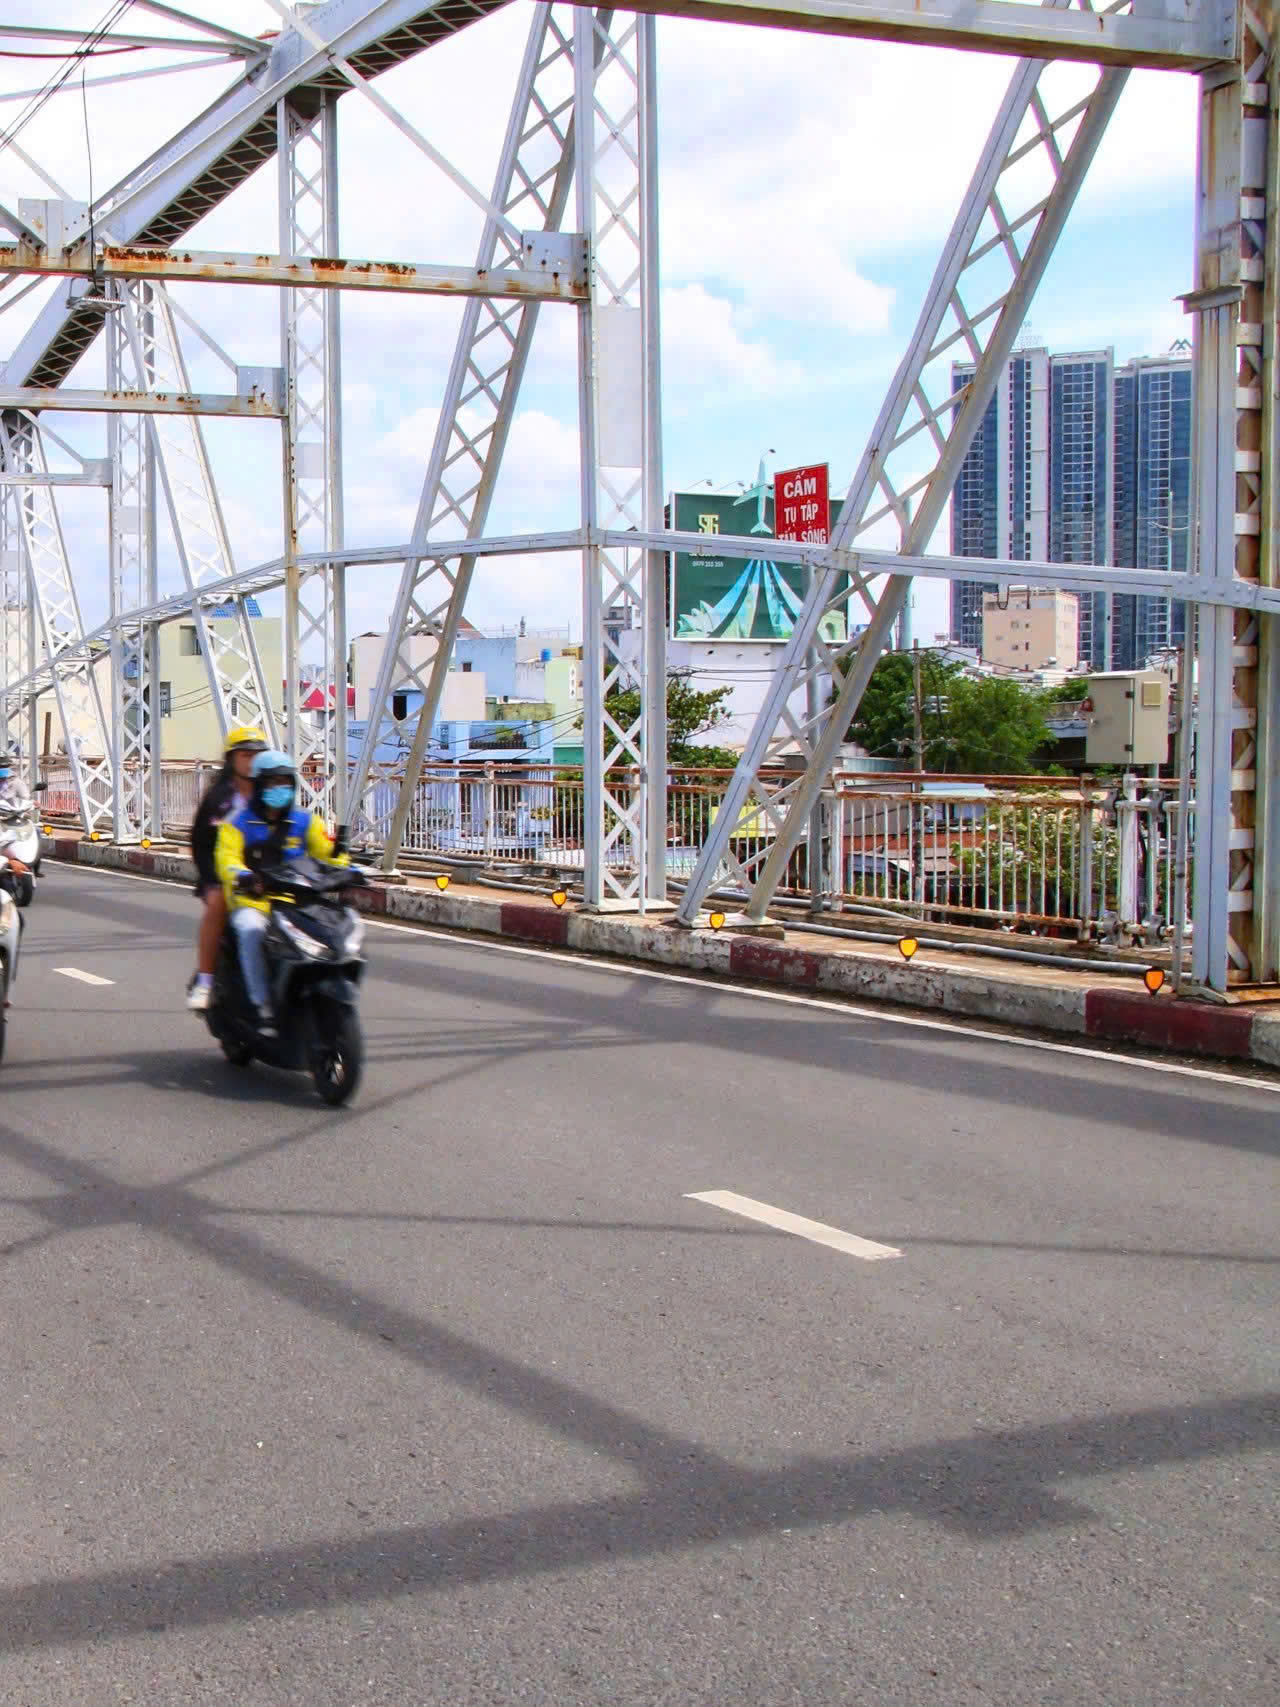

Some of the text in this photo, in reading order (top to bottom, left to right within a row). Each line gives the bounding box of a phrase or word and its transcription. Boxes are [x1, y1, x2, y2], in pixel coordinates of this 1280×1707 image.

[784, 471, 817, 498] CẤM
[784, 499, 819, 527] TỤ TẬP
